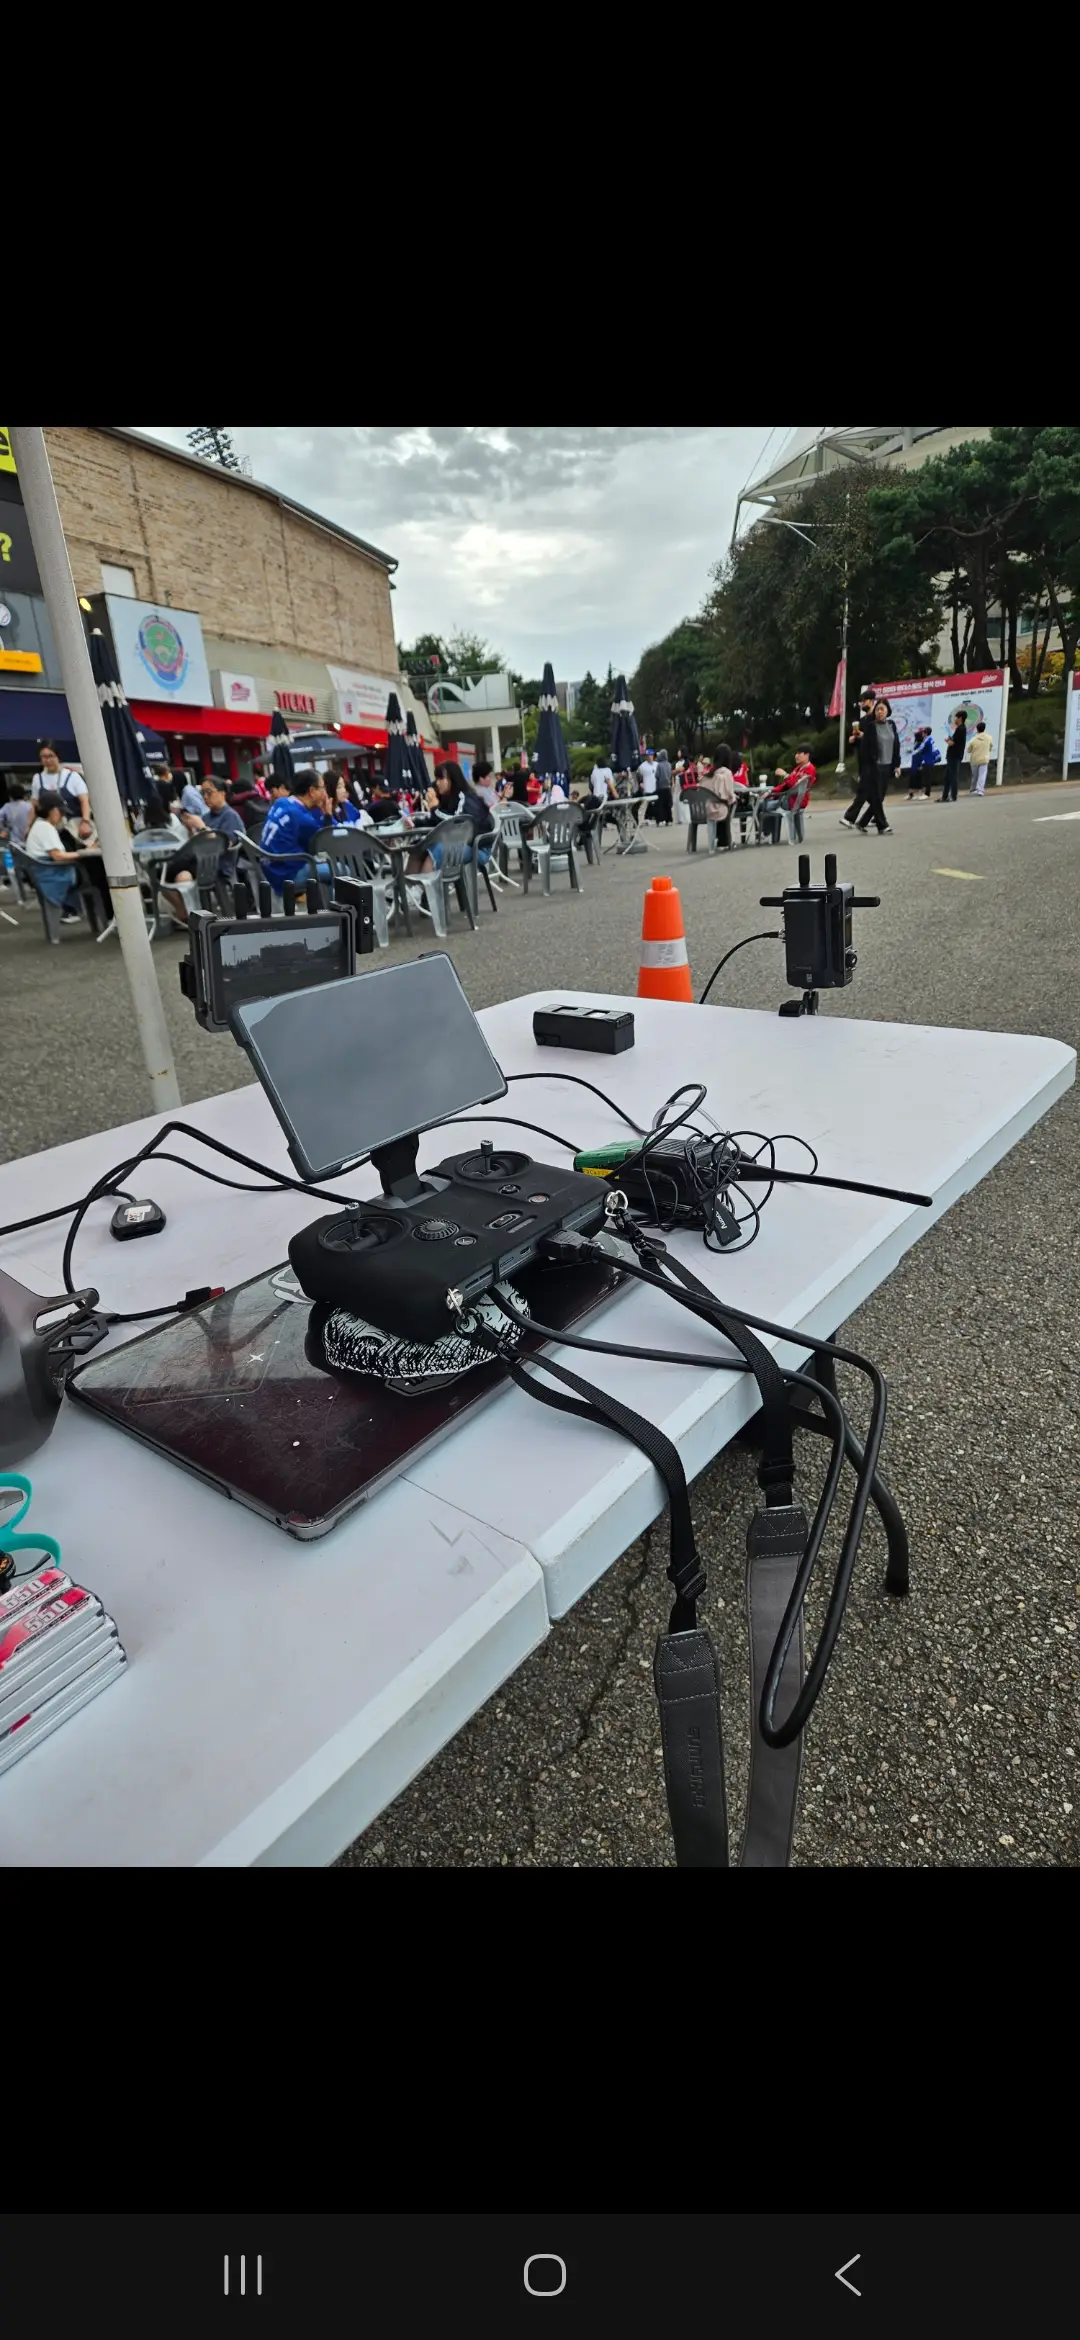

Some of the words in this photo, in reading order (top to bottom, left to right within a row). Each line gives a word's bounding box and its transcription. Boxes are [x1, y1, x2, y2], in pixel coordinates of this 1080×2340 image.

[275, 690, 317, 714] TICKET
[2, 1579, 45, 1609] 550
[23, 1599, 69, 1632] 550
